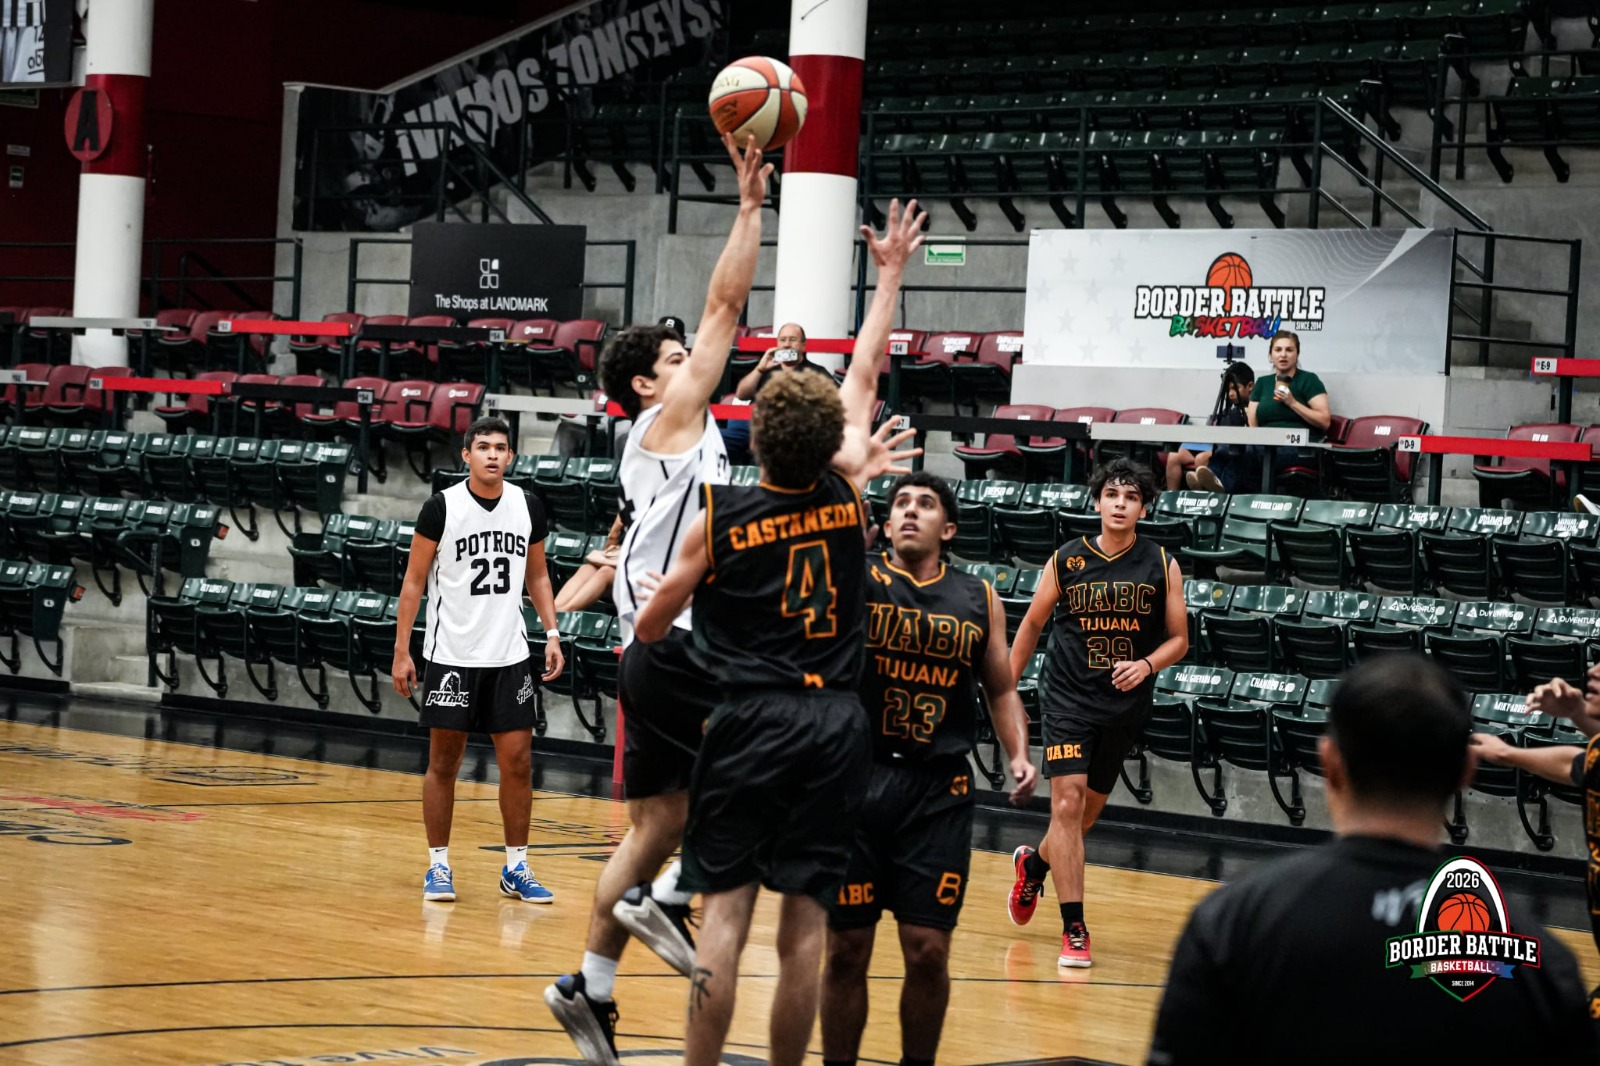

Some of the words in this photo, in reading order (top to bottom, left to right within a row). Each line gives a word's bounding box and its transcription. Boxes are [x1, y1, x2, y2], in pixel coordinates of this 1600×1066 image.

[73, 90, 100, 152] A
[435, 294, 451, 309] The
[452, 294, 479, 312] Shops
[480, 296, 489, 310] at
[490, 296, 549, 312] LANDMARK
[1134, 286, 1226, 319] BORDER
[1229, 287, 1325, 321] BATTLE
[1295, 321, 1309, 331] SINCE
[1309, 321, 1322, 331] 2014
[1540, 360, 1551, 371] E-9
[1290, 434, 1301, 444] D-8
[1404, 439, 1415, 450] D-9
[455, 530, 526, 562] POTROS
[470, 557, 511, 596] 23
[782, 539, 838, 640] 4
[1066, 581, 1156, 615] UABC
[865, 602, 984, 667] UABC
[1079, 617, 1140, 632] TIJUANA
[1087, 636, 1134, 669] 29
[875, 655, 959, 688] TIJUANA
[882, 687, 947, 744] 23
[1046, 744, 1082, 762] UABC
[837, 881, 875, 906] ABC
